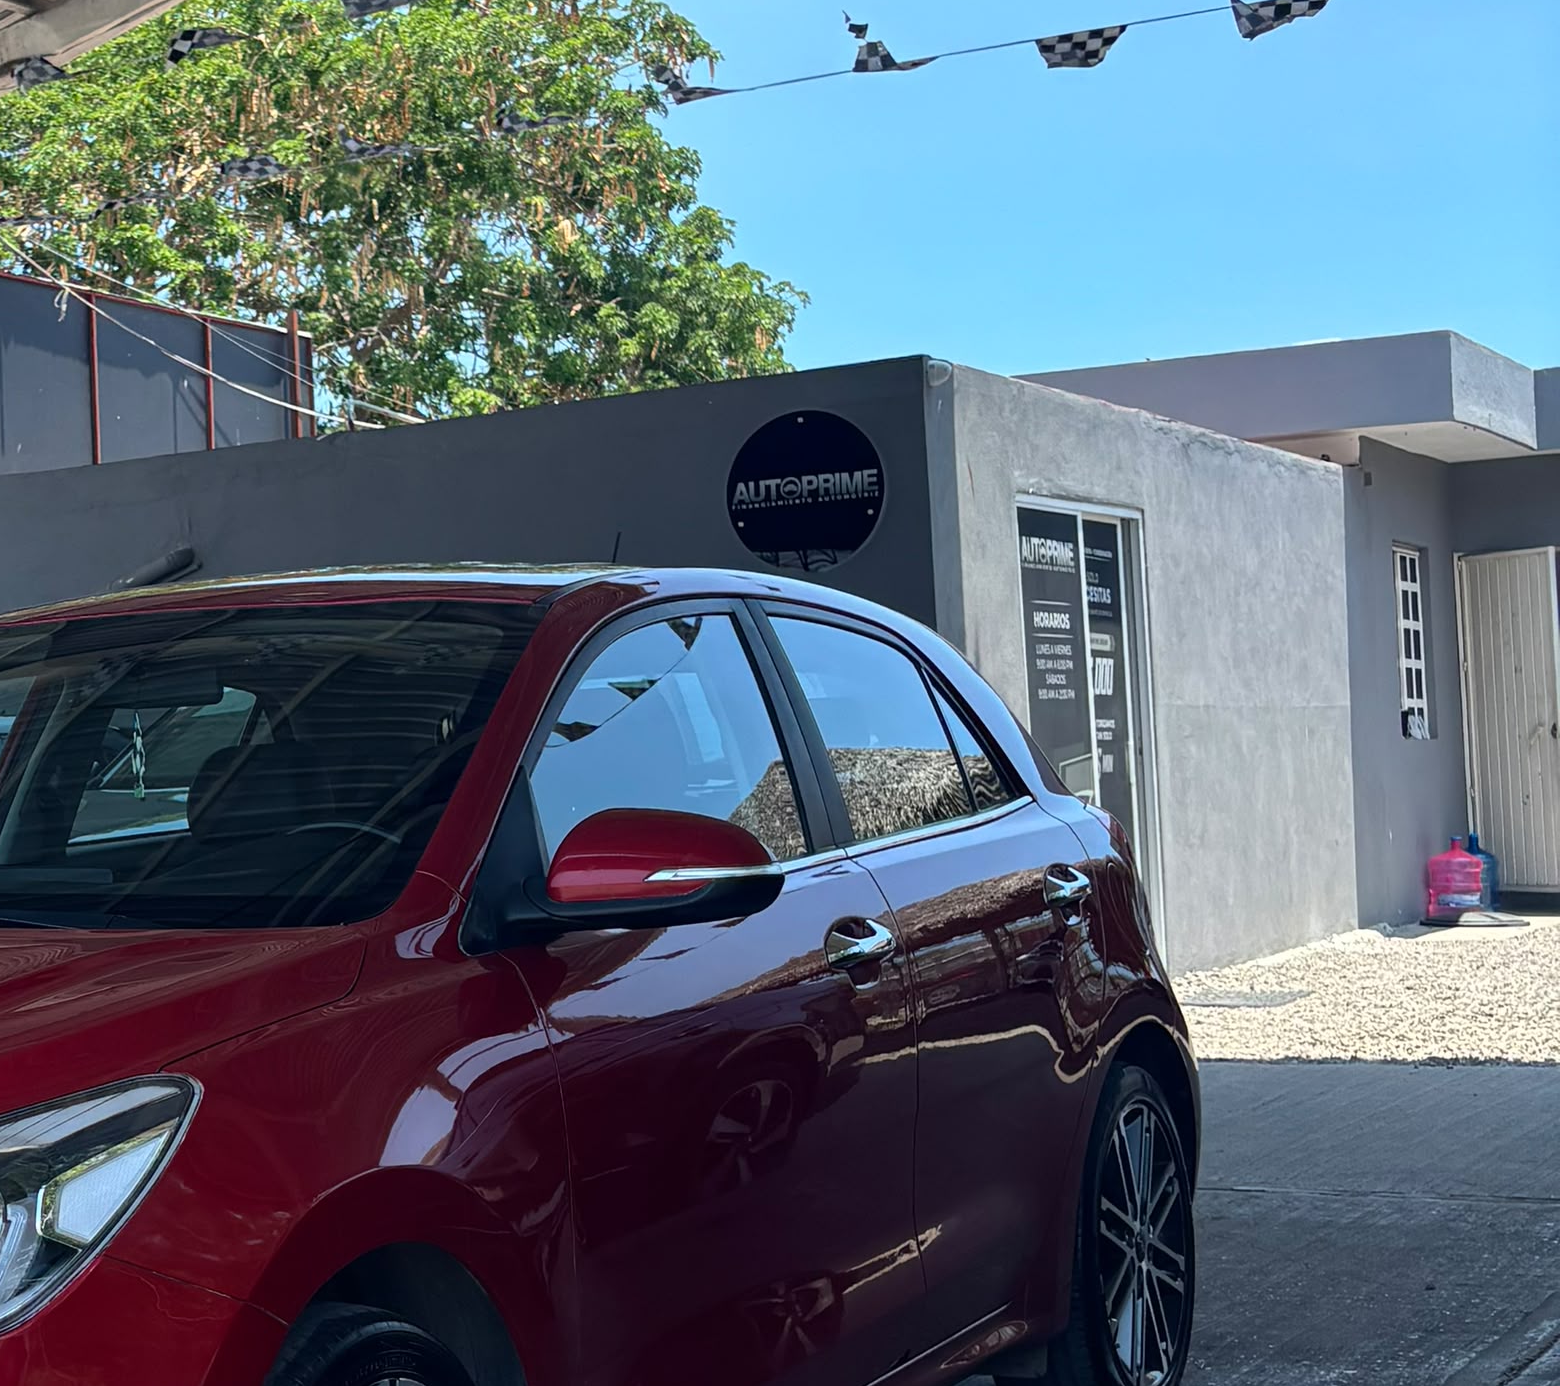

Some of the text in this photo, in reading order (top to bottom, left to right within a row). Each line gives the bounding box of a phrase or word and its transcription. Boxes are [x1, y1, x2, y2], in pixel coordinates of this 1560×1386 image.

[733, 469, 878, 504] AUTOPRIME
[1021, 536, 1075, 567] AUTOPRIME
[1033, 611, 1071, 630] HORARIOS
